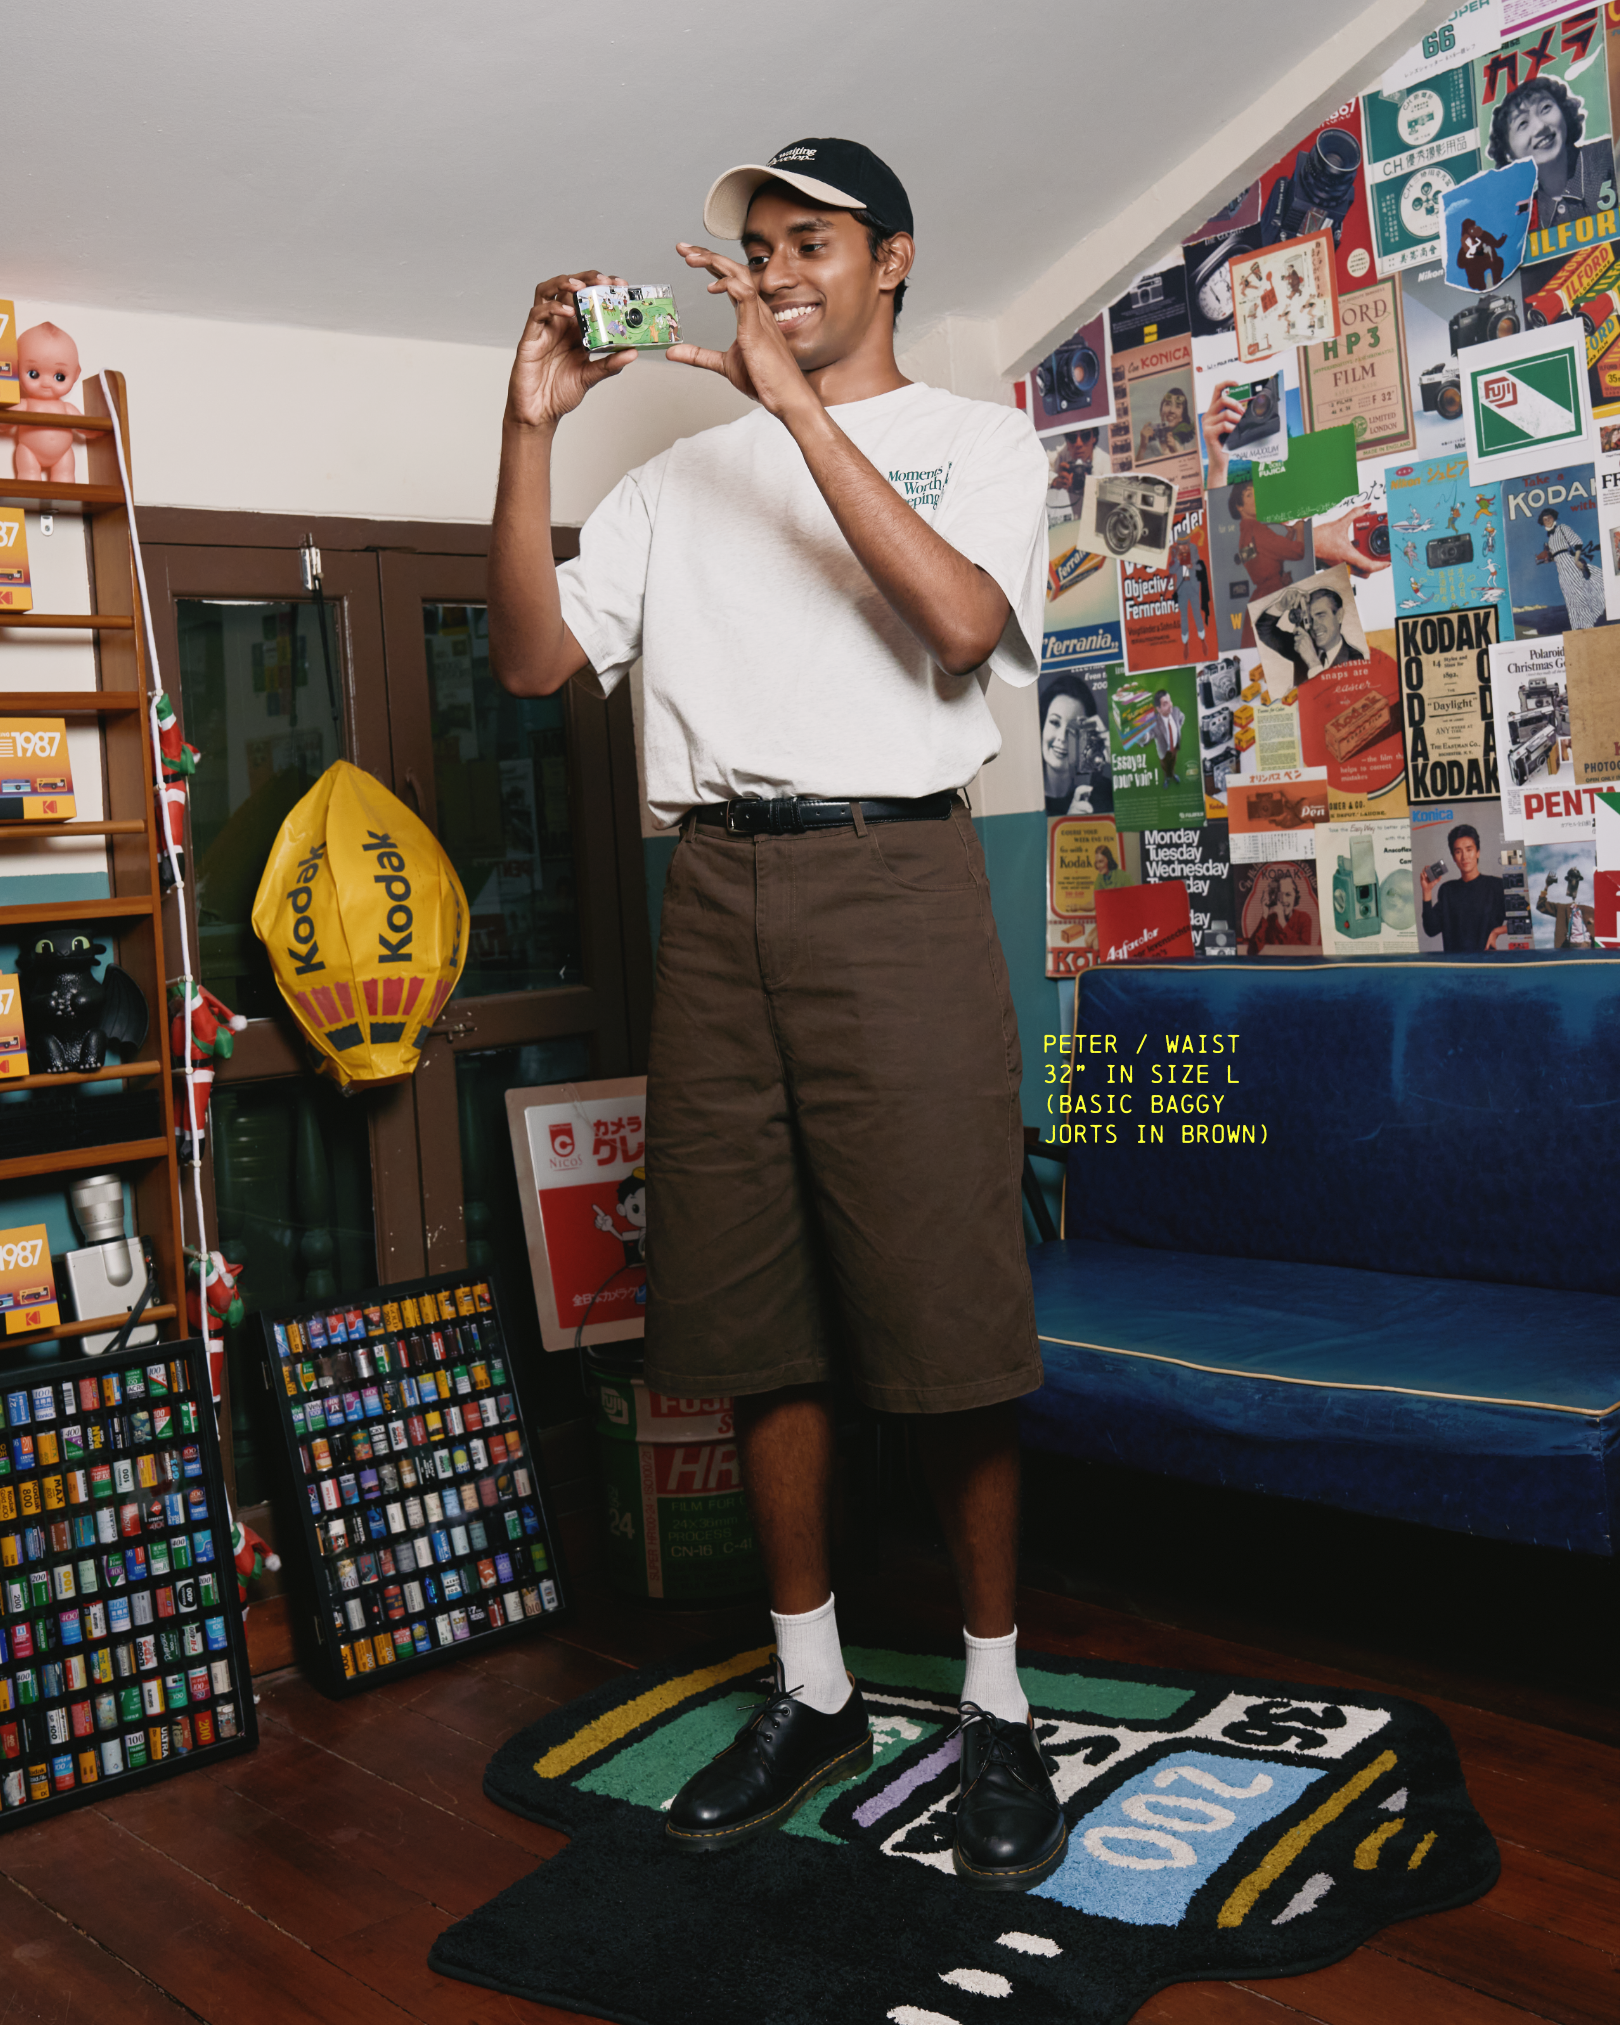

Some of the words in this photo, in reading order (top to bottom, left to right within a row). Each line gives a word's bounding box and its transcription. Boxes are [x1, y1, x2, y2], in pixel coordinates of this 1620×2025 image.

[1422, 24, 1456, 59] 66
[1481, 3, 1601, 106] カメラ
[1597, 180, 1617, 211] 5
[1530, 210, 1617, 257] ILFOR
[1418, 269, 1443, 282] Nikon
[1566, 247, 1609, 300] ILFORD
[1342, 299, 1387, 326] ORD
[1140, 346, 1191, 369] KONICA
[1332, 362, 1376, 387] FILM
[1369, 412, 1397, 424] LIMITED
[1370, 423, 1398, 435] LONDON
[1385, 440, 1411, 451] ENGLAND
[1259, 466, 1286, 478] FUJICA
[904, 477, 942, 495] Worth
[1391, 477, 1421, 490] Nikon
[1523, 474, 1550, 488] Take
[906, 493, 940, 510] eping
[1570, 499, 1596, 512] with
[1402, 610, 1492, 657] KODAK
[1529, 646, 1565, 660] Polaroid
[1432, 660, 1442, 668] 14
[1507, 661, 1554, 674] Christmas
[1085, 672, 1104, 681] Even
[1321, 671, 1348, 681] snaps
[1353, 668, 1369, 677] are
[1333, 680, 1379, 694] easier
[1331, 695, 1377, 732] Kodak
[1436, 726, 1450, 735] ANY
[11, 731, 61, 757] 1987
[1112, 753, 1147, 771] Essayez
[1380, 753, 1393, 761] film
[1249, 773, 1281, 784] オリンパス
[1284, 769, 1302, 781] ペン
[1340, 766, 1357, 774] helps
[1370, 763, 1392, 771] correct
[1113, 775, 1133, 792] pour
[1135, 770, 1153, 786] voir
[1411, 757, 1500, 799] KODAK
[1209, 803, 1225, 811] Kodak
[1301, 805, 1325, 817] Pen
[1524, 786, 1616, 820] PENT
[1412, 808, 1453, 823] Konica
[1145, 828, 1200, 845] Monday
[1060, 855, 1093, 869] Kodak
[1146, 845, 1202, 862] Tuesday
[1146, 859, 1229, 879] Wednesday
[1262, 868, 1301, 880] KODAK
[361, 829, 414, 964] Kodak
[286, 840, 327, 976] Kodak
[1106, 928, 1159, 961] Agfacolor
[593, 1115, 642, 1136] カメラ
[549, 1154, 583, 1169] NICOS
[0, 1239, 43, 1271] 1987
[34, 1388, 50, 1397] 100
[660, 1394, 731, 1414] FUJI
[153, 1409, 165, 1418] 100
[66, 1428, 79, 1436] 400
[87, 1427, 95, 1450] ILFORD
[92, 1425, 102, 1449] PAN
[170, 1459, 180, 1480] GP3
[666, 1443, 744, 1491] HR
[22, 1489, 33, 1508] 800
[32, 1482, 40, 1511] Kodak
[54, 1479, 64, 1504] MAX
[671, 1501, 703, 1511] FILM
[708, 1498, 735, 1509] FOR
[609, 1508, 635, 1539] 24
[172, 1538, 185, 1546] 400
[668, 1528, 732, 1542] PROCESS
[671, 1544, 713, 1558] CN-16
[723, 1538, 752, 1553] C-41
[649, 1549, 661, 1581] SUPER
[31, 1573, 45, 1582] 200
[63, 1571, 73, 1592] 100
[14, 1594, 22, 1609] 200
[61, 1612, 78, 1621] 400
[366, 1652, 374, 1668] 200
[385, 1645, 394, 1661] 200
[49, 1725, 58, 1740] 100
[198, 1719, 211, 1740] 200
[128, 1734, 144, 1745] 100
[160, 1726, 169, 1758] ULTRA
[1081, 1764, 1273, 1872] 200
